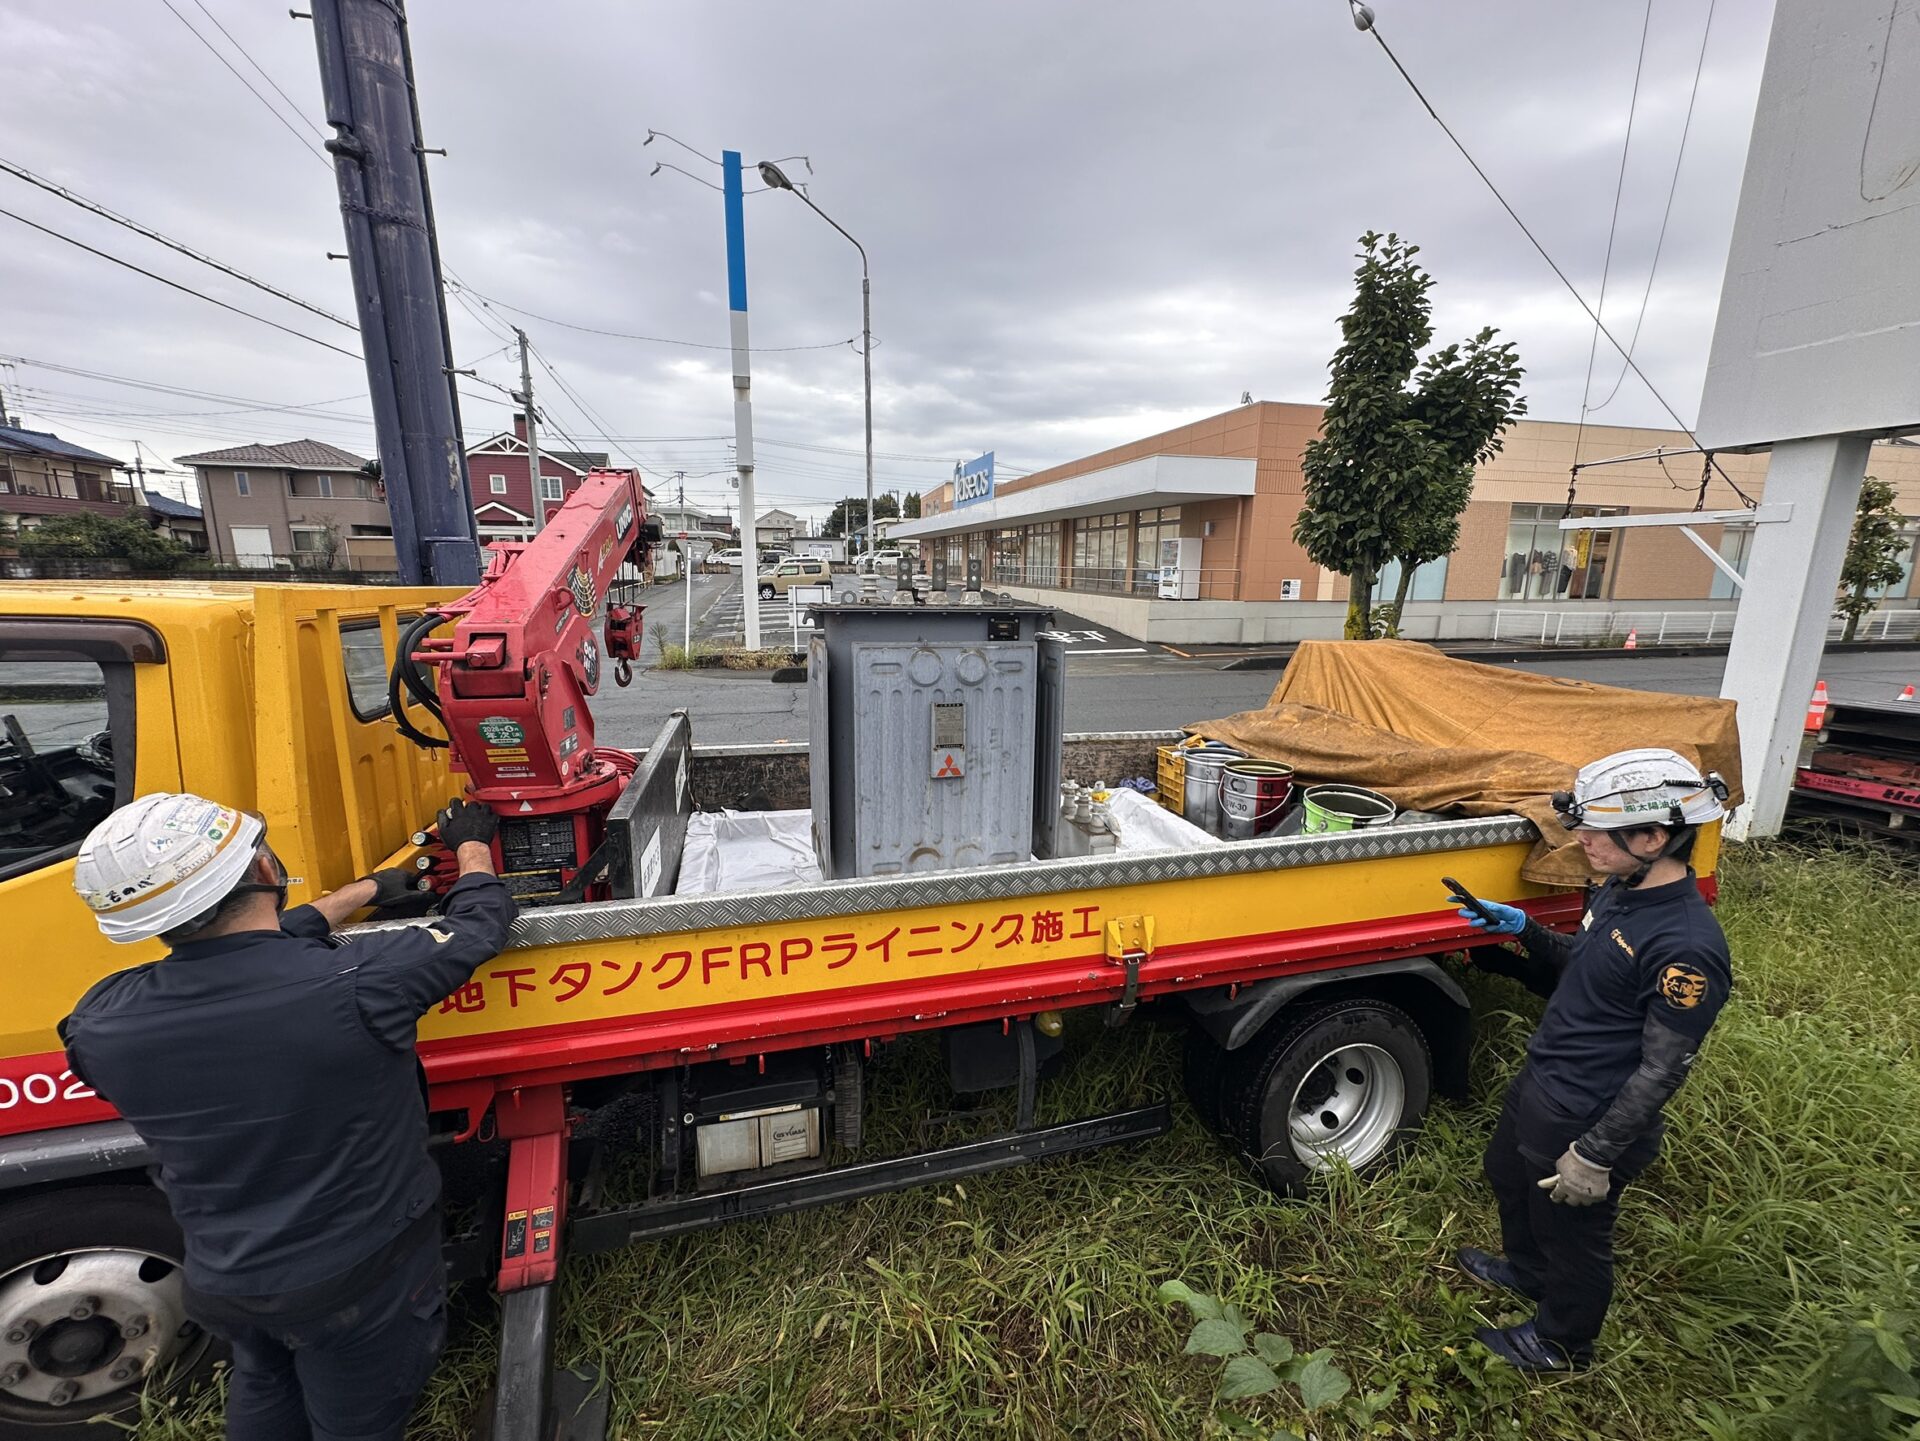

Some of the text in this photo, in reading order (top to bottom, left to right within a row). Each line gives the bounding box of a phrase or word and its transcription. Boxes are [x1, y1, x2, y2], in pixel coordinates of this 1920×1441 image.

[615, 503, 632, 540] UNIC
[438, 905, 1101, 1014] 地下タンクFRPライニング施工
